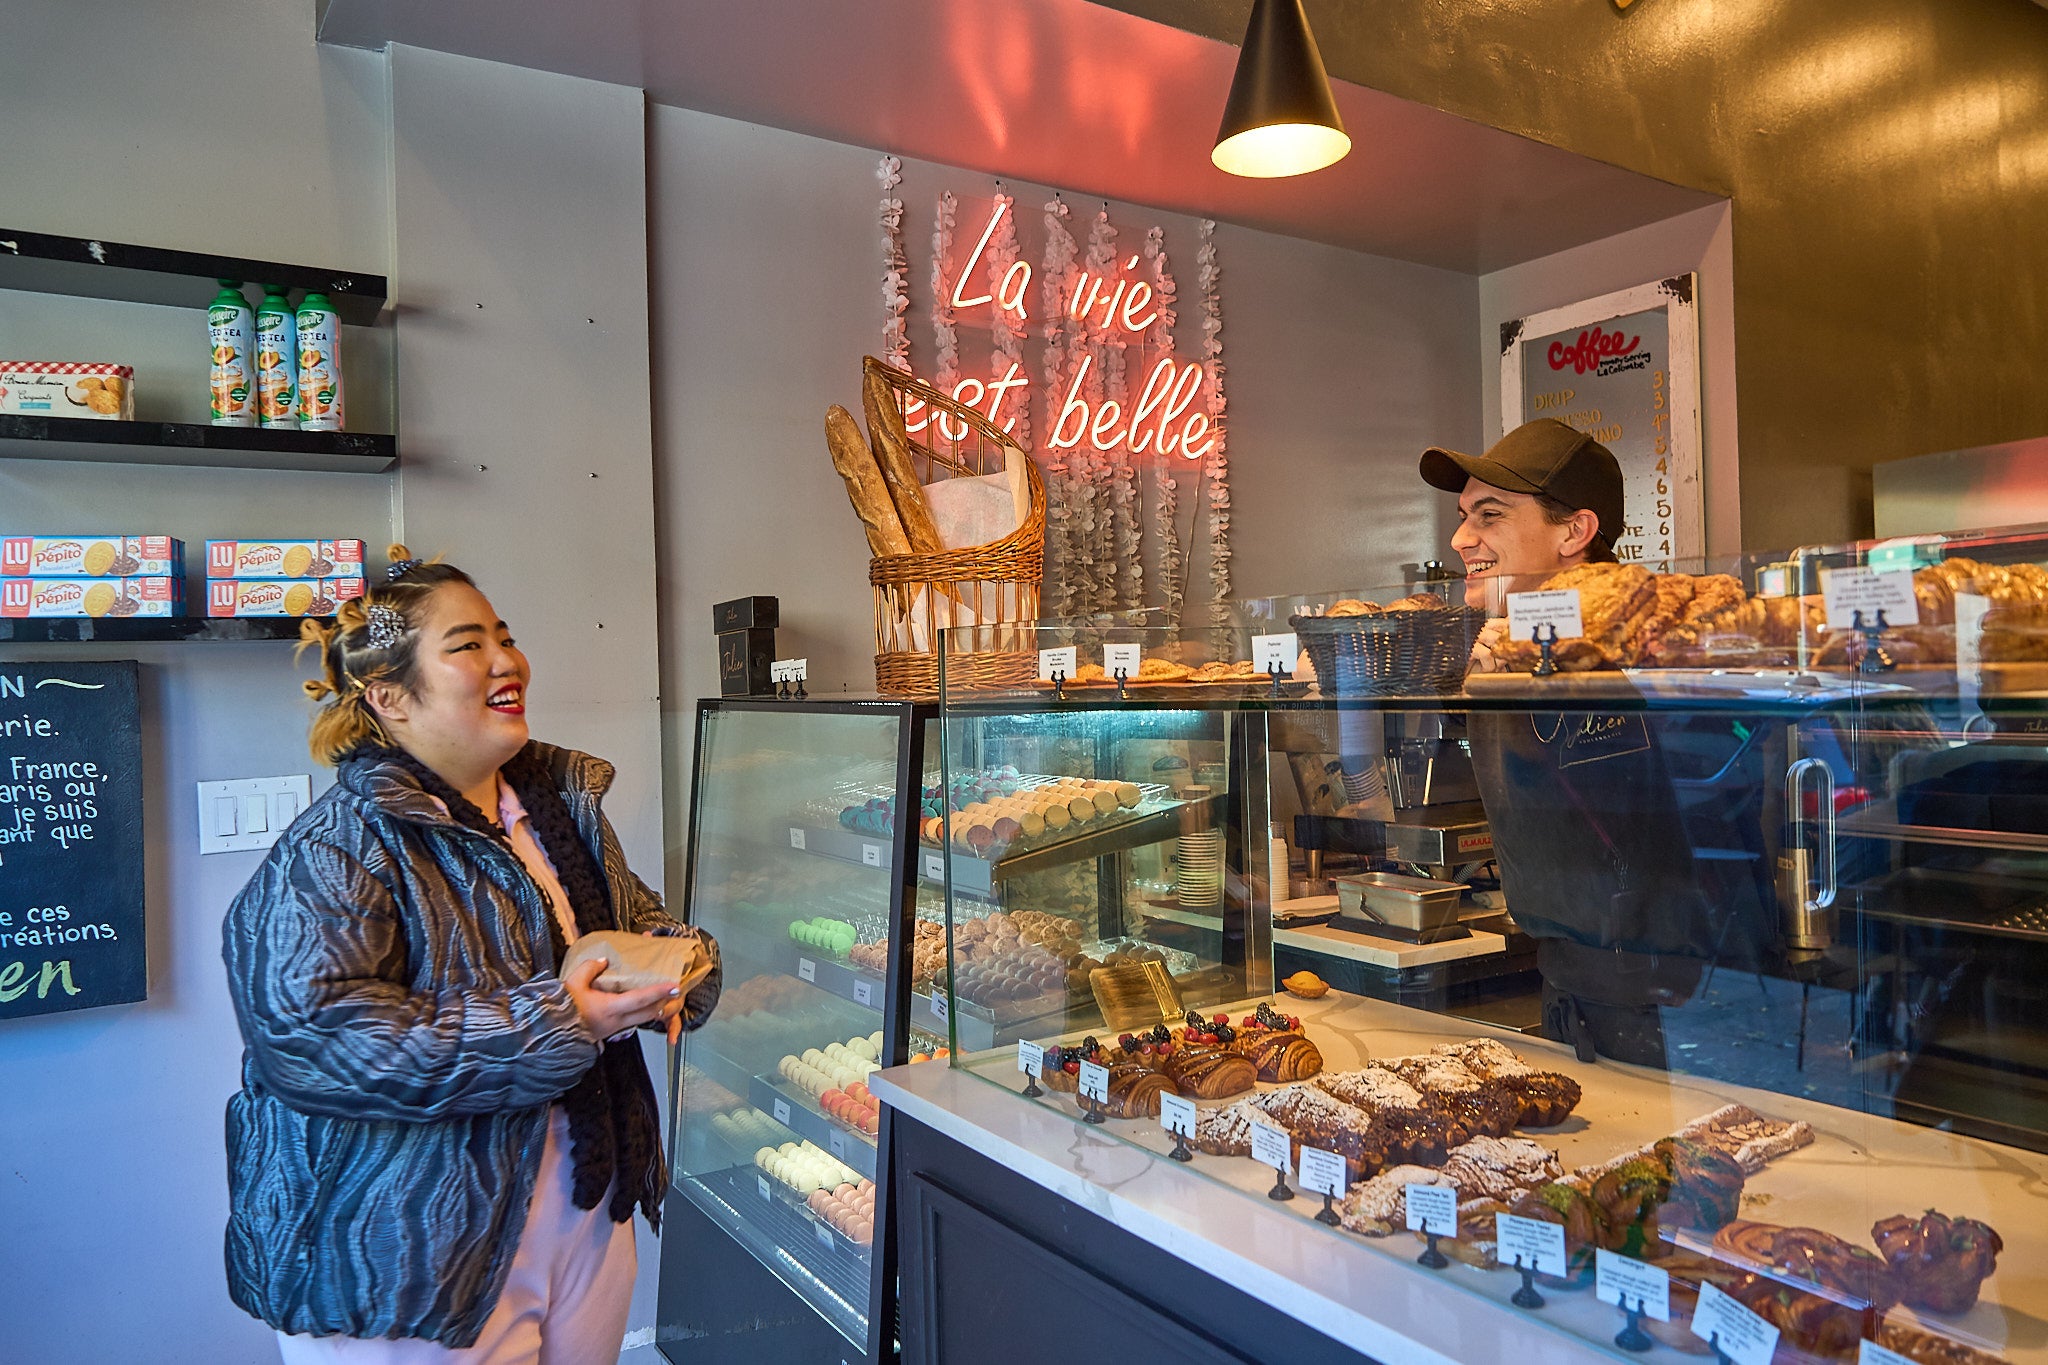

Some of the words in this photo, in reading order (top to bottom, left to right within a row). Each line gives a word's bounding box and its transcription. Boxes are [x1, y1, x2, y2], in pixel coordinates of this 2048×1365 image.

[952, 202, 1032, 320] La
[1070, 255, 1158, 332] vie
[224, 328, 242, 337] TEA
[269, 334, 286, 343] TEA
[310, 332, 327, 341] TEA
[1548, 326, 1641, 376] Coffee
[1533, 389, 1576, 411] DRIP
[1652, 369, 1664, 390] 3
[902, 363, 1029, 442] est
[1047, 355, 1215, 461] belle
[1653, 391, 1665, 411] 3
[1654, 436, 1667, 455] 5
[1655, 457, 1668, 476] 4
[1656, 478, 1668, 495] 6
[1656, 500, 1672, 518] 5
[1659, 521, 1670, 536] 6
[5, 542, 29, 565] LU
[35, 548, 82, 567] Pépito
[212, 545, 233, 568] LU
[1659, 539, 1670, 556] 4
[238, 552, 281, 570] Pépito
[5, 583, 29, 607] LU
[35, 589, 82, 608] Pépito
[213, 584, 234, 607] LU
[239, 590, 282, 609] Pépito
[0, 675, 25, 698] N
[0, 714, 60, 737] rie.
[10, 756, 108, 782] France,
[0, 781, 52, 804] aris
[64, 781, 96, 797] ou
[11, 804, 36, 832] je
[44, 799, 98, 821] suis
[0, 823, 35, 844] ant
[51, 823, 94, 849] que
[26, 905, 71, 923] ces
[0, 923, 118, 948] réations.
